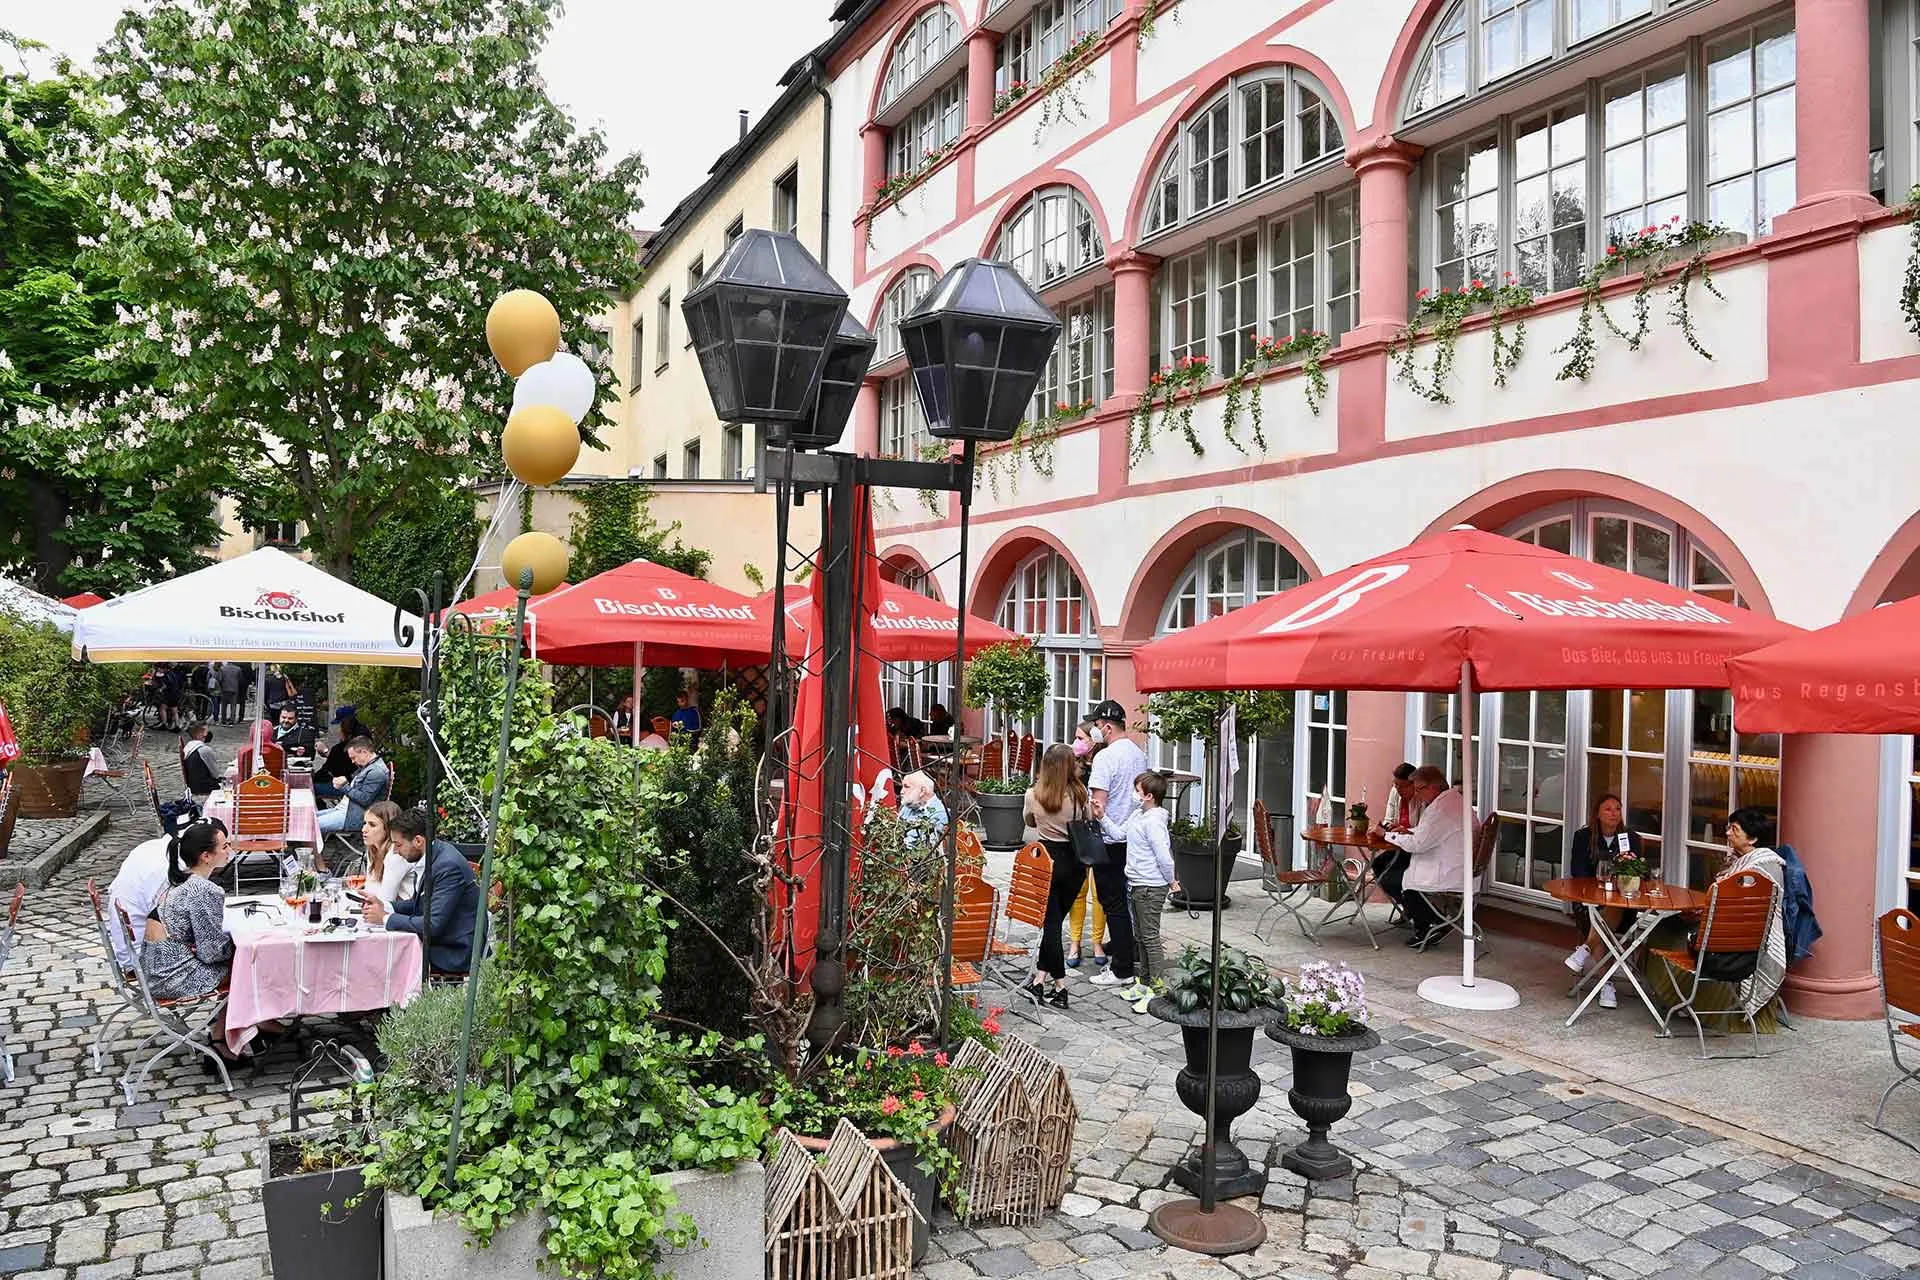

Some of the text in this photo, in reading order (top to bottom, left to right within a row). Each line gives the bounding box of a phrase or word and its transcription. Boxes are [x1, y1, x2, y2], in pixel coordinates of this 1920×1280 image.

[657, 587, 678, 600] B
[219, 605, 346, 624] Bischofshof
[594, 597, 757, 620] Bischofshof
[885, 600, 900, 613] B
[1507, 591, 1731, 624] Bischofshof
[1562, 647, 1586, 663] Das
[1592, 646, 1621, 665] Bier,
[1625, 648, 1648, 664] das
[1651, 650, 1673, 664] uns
[1677, 651, 1690, 665] zu
[1739, 684, 1782, 700] Aus
